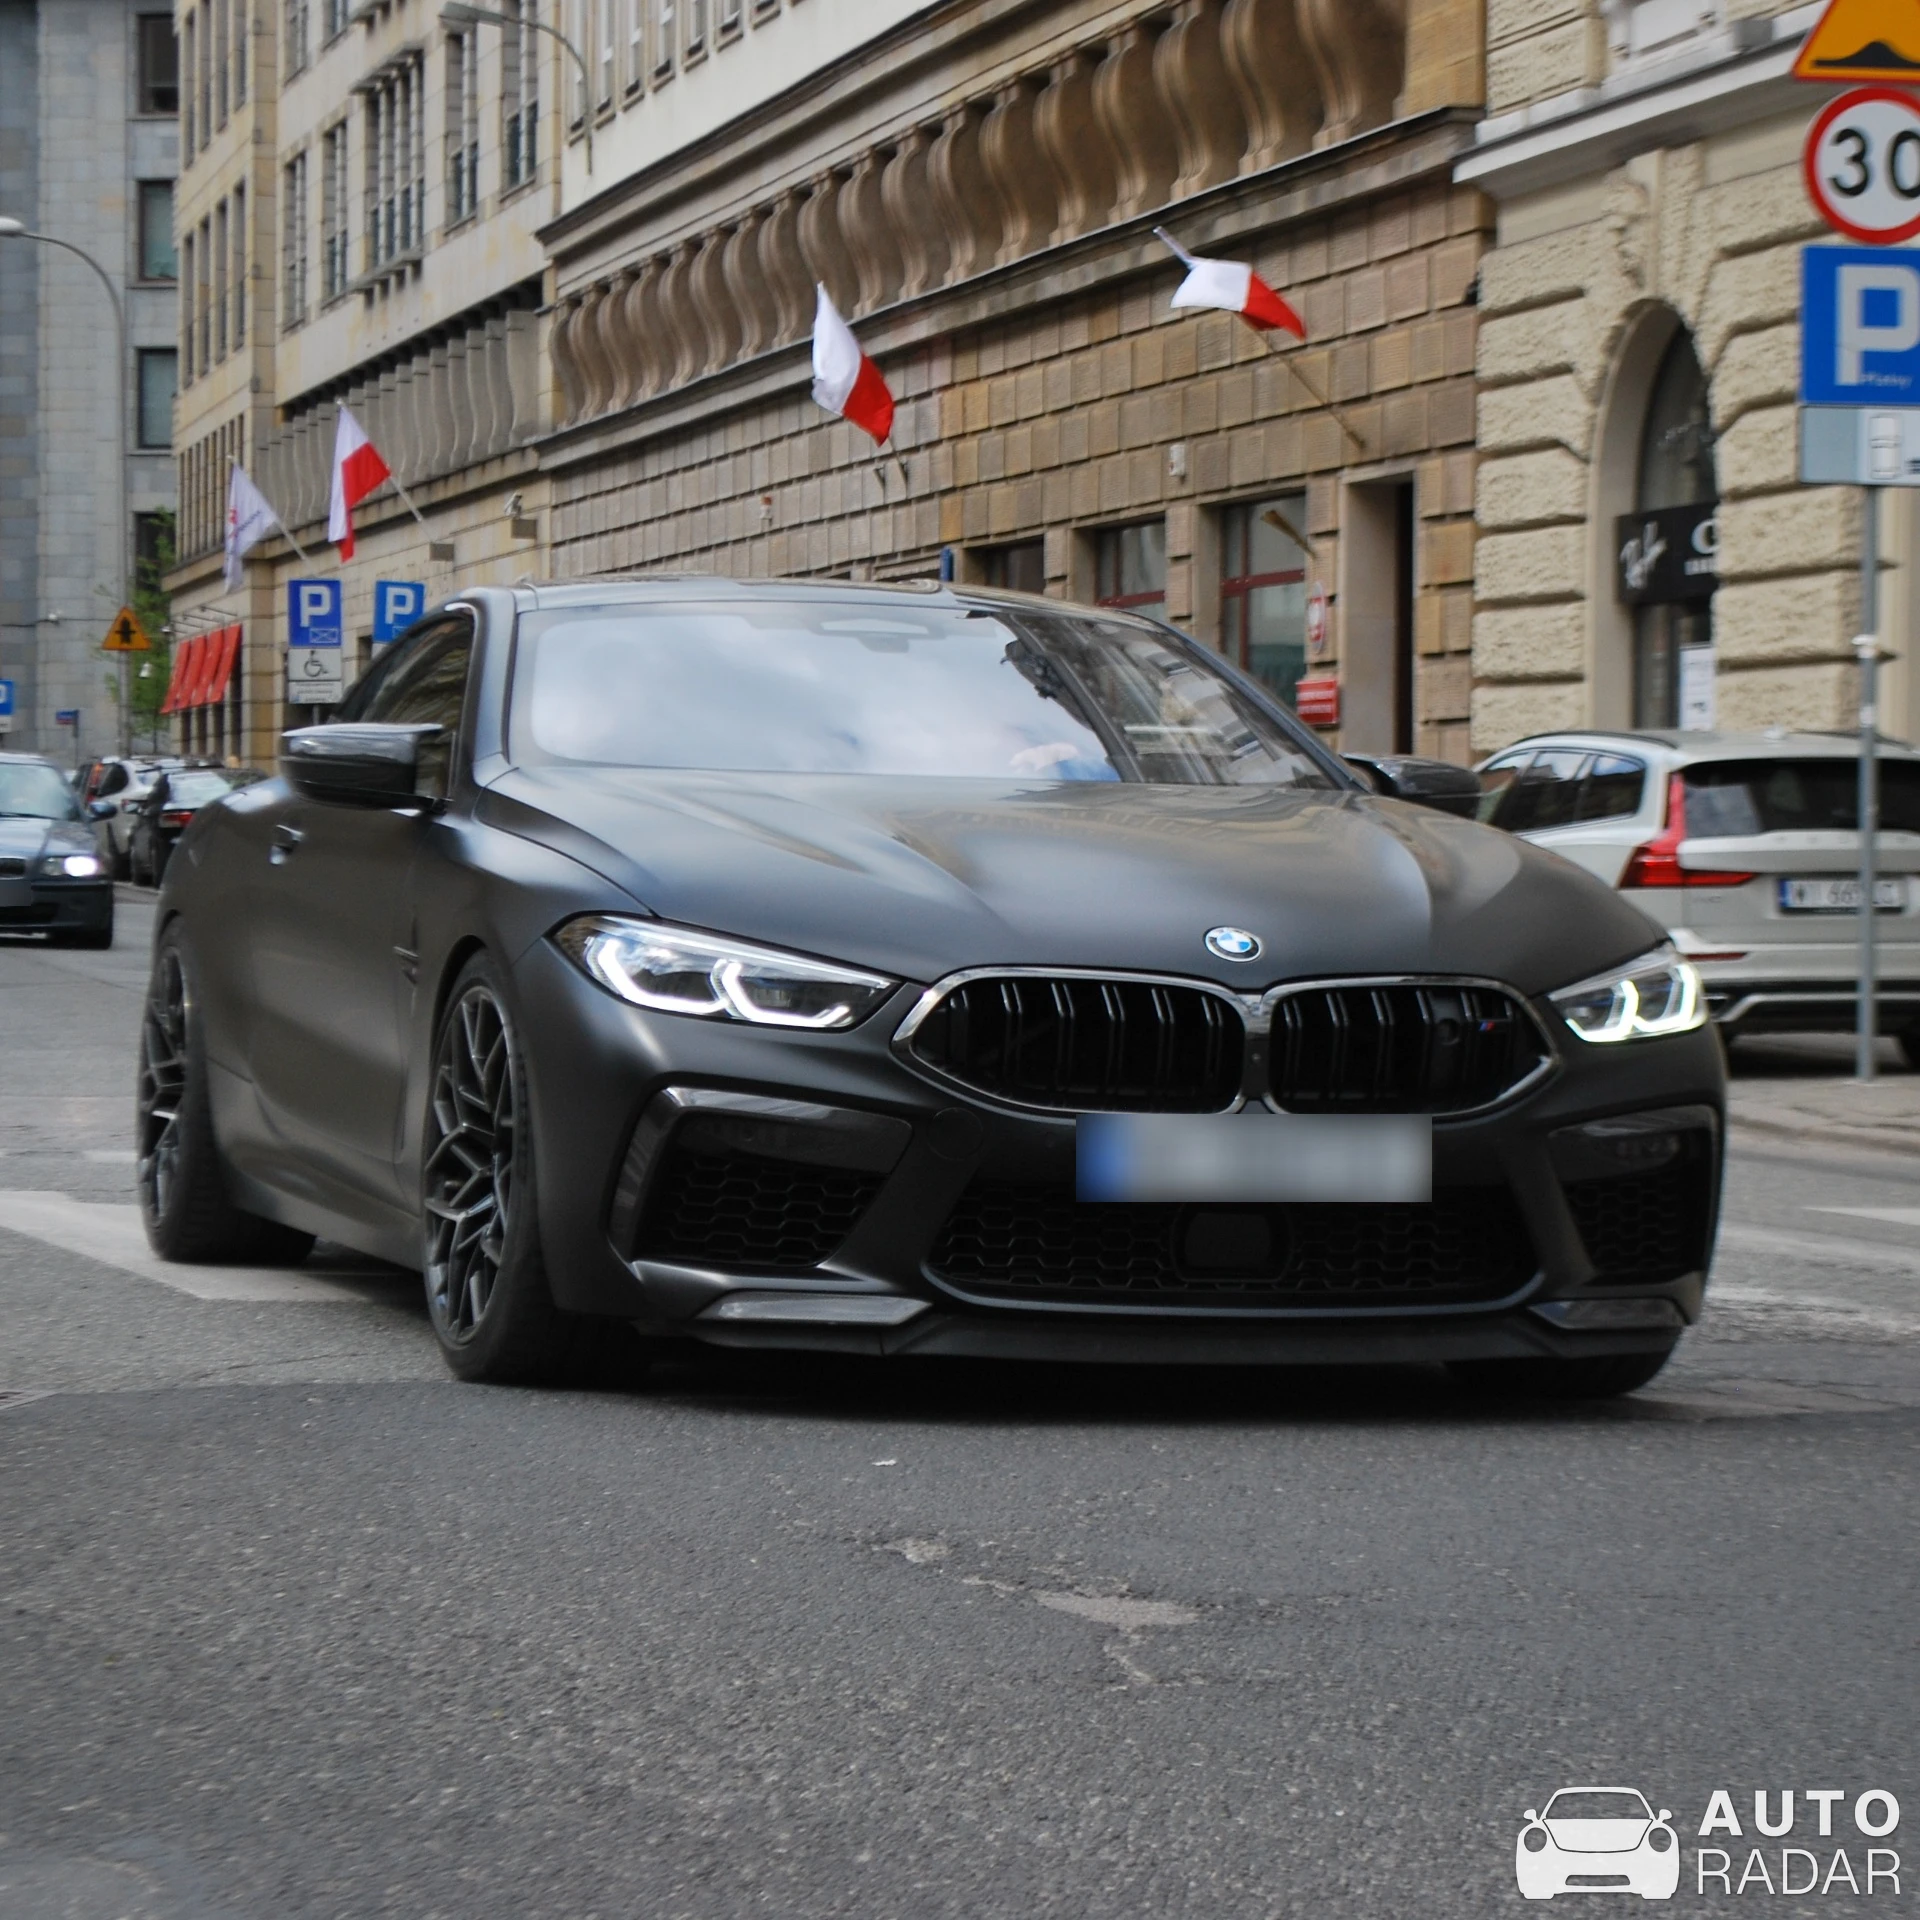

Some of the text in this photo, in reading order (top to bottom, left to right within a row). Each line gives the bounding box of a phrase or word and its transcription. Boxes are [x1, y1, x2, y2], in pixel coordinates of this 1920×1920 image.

[1828, 127, 1920, 200] 30
[1836, 264, 1920, 386] P
[301, 585, 331, 627] P
[384, 586, 415, 625] P
